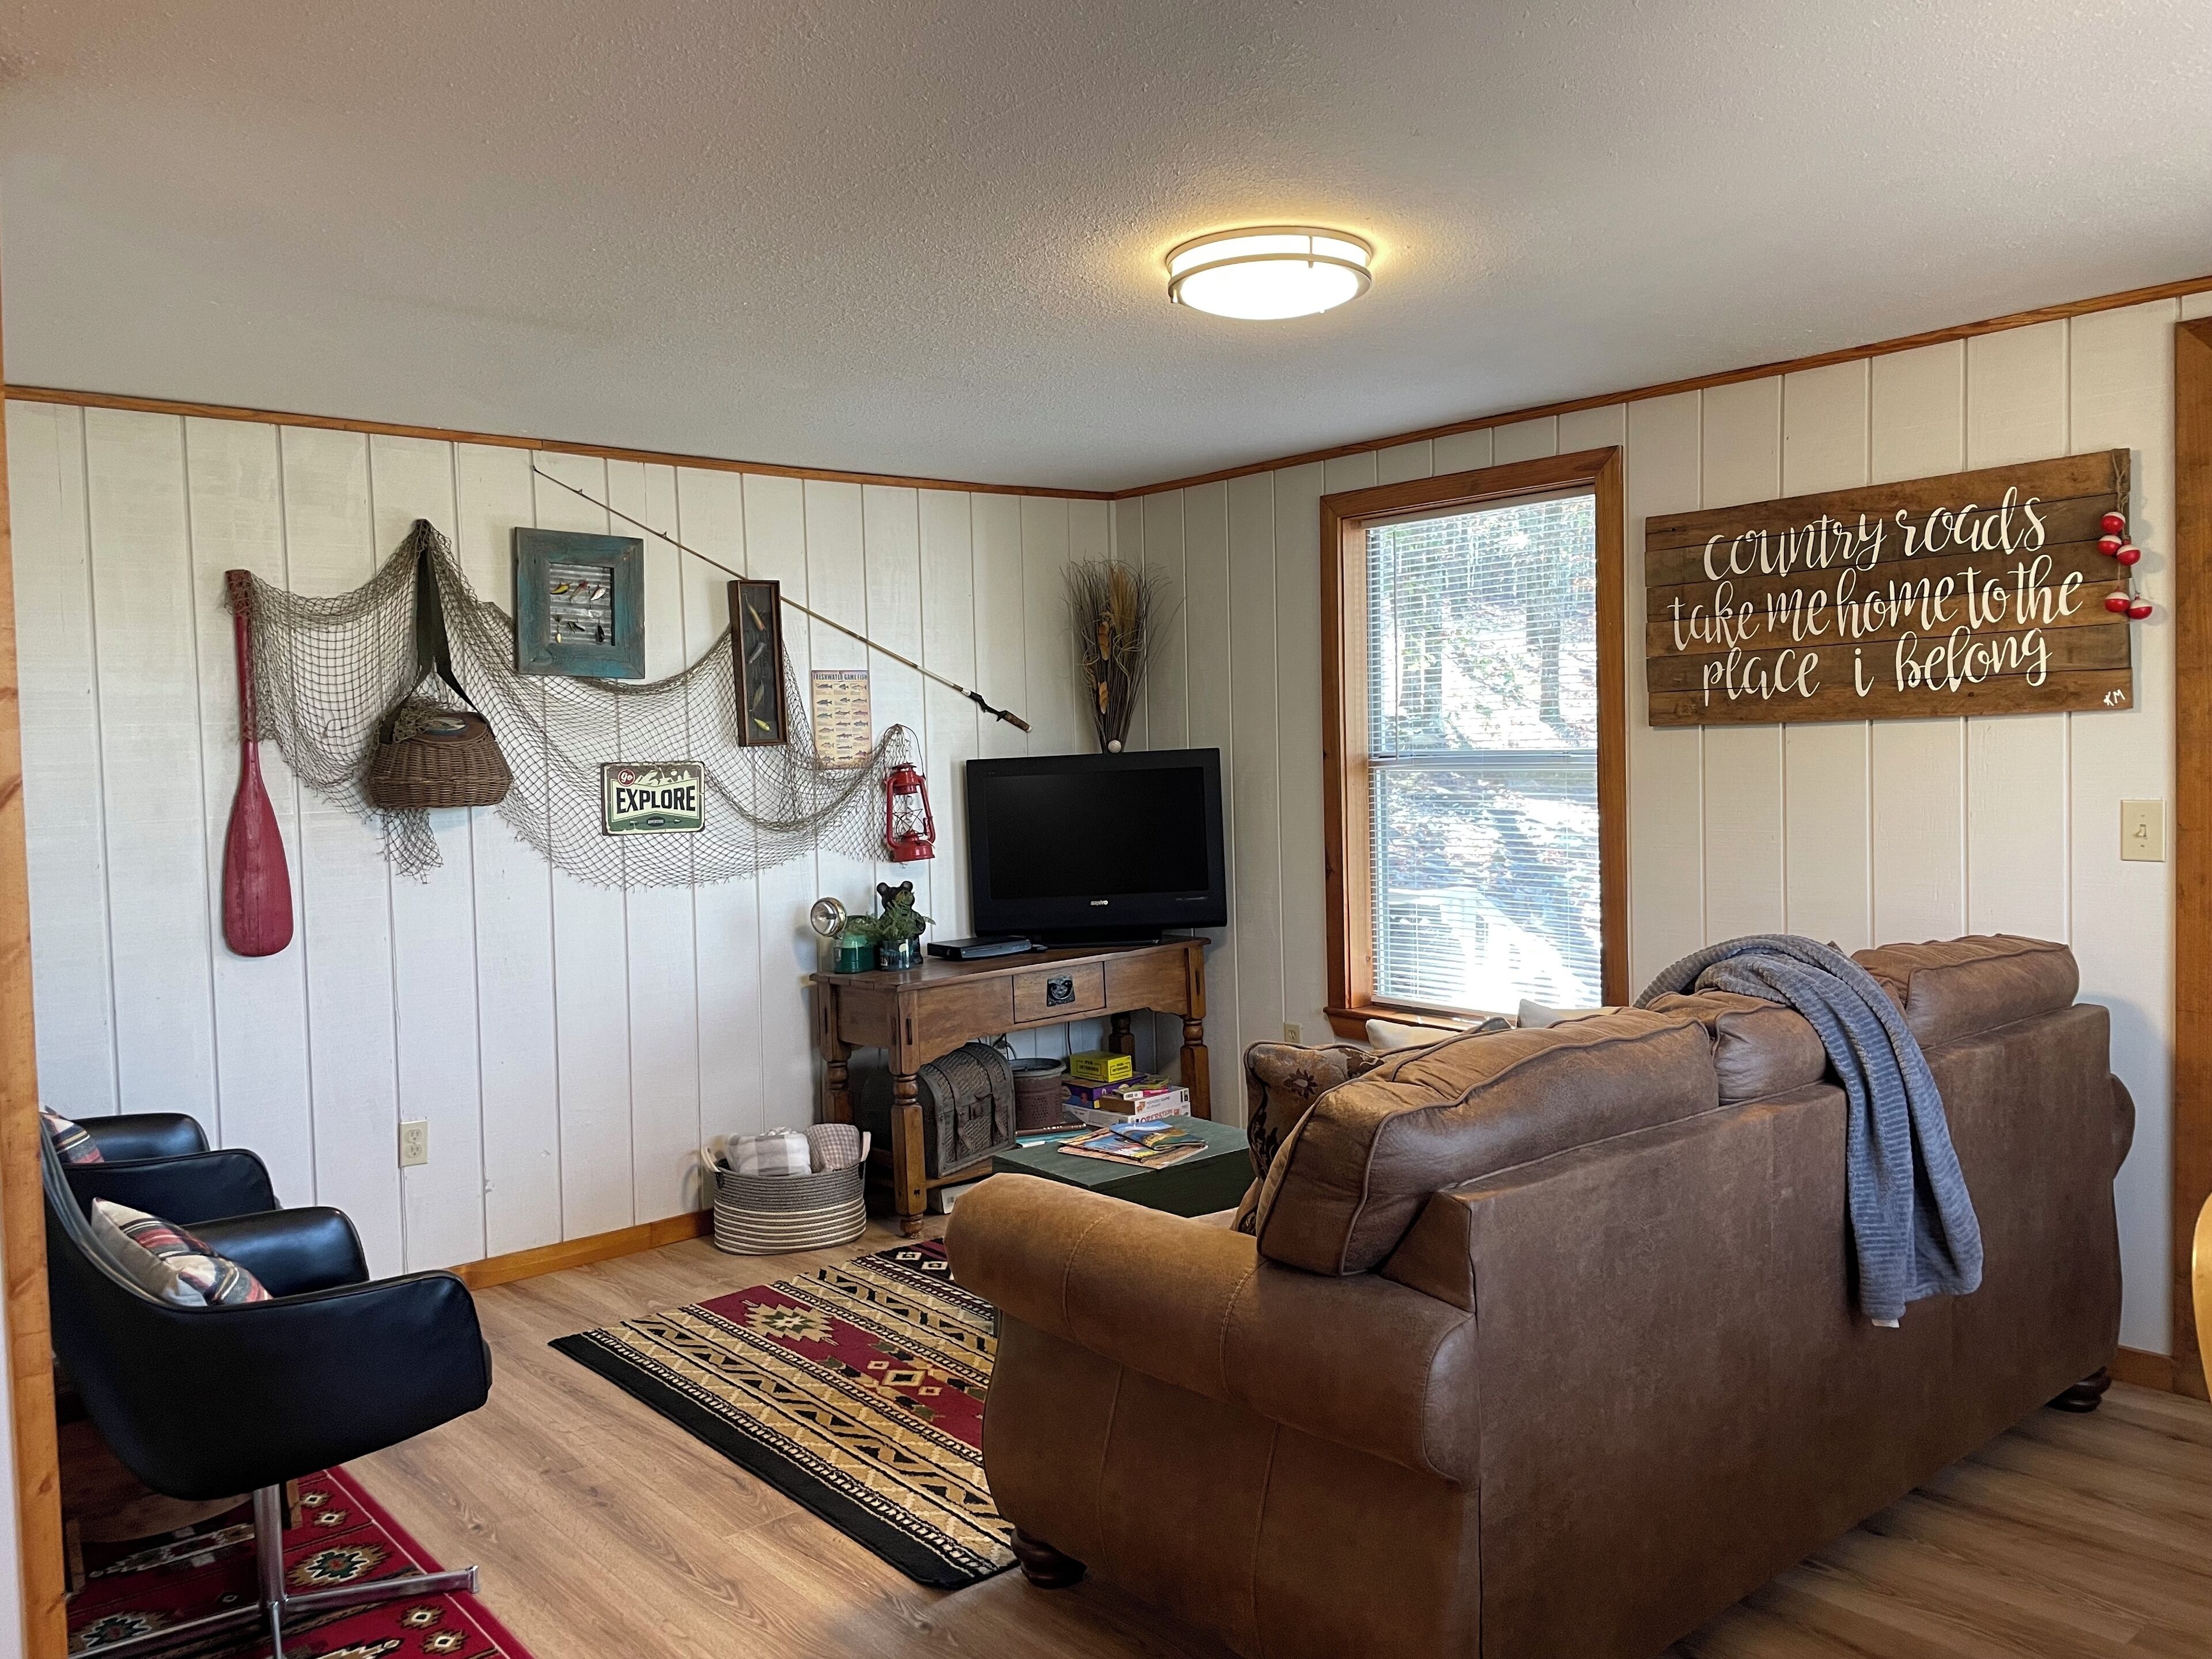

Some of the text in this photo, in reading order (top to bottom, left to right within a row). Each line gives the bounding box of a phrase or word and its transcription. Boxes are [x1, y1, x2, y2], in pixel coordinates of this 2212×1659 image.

[1704, 486, 2047, 580] country roads
[1667, 555, 2083, 651] take me home to the
[1703, 626, 2052, 707] place i belong
[2103, 689, 2126, 706] KM
[616, 786, 696, 814] EXPLORE
[621, 772, 633, 782] go
